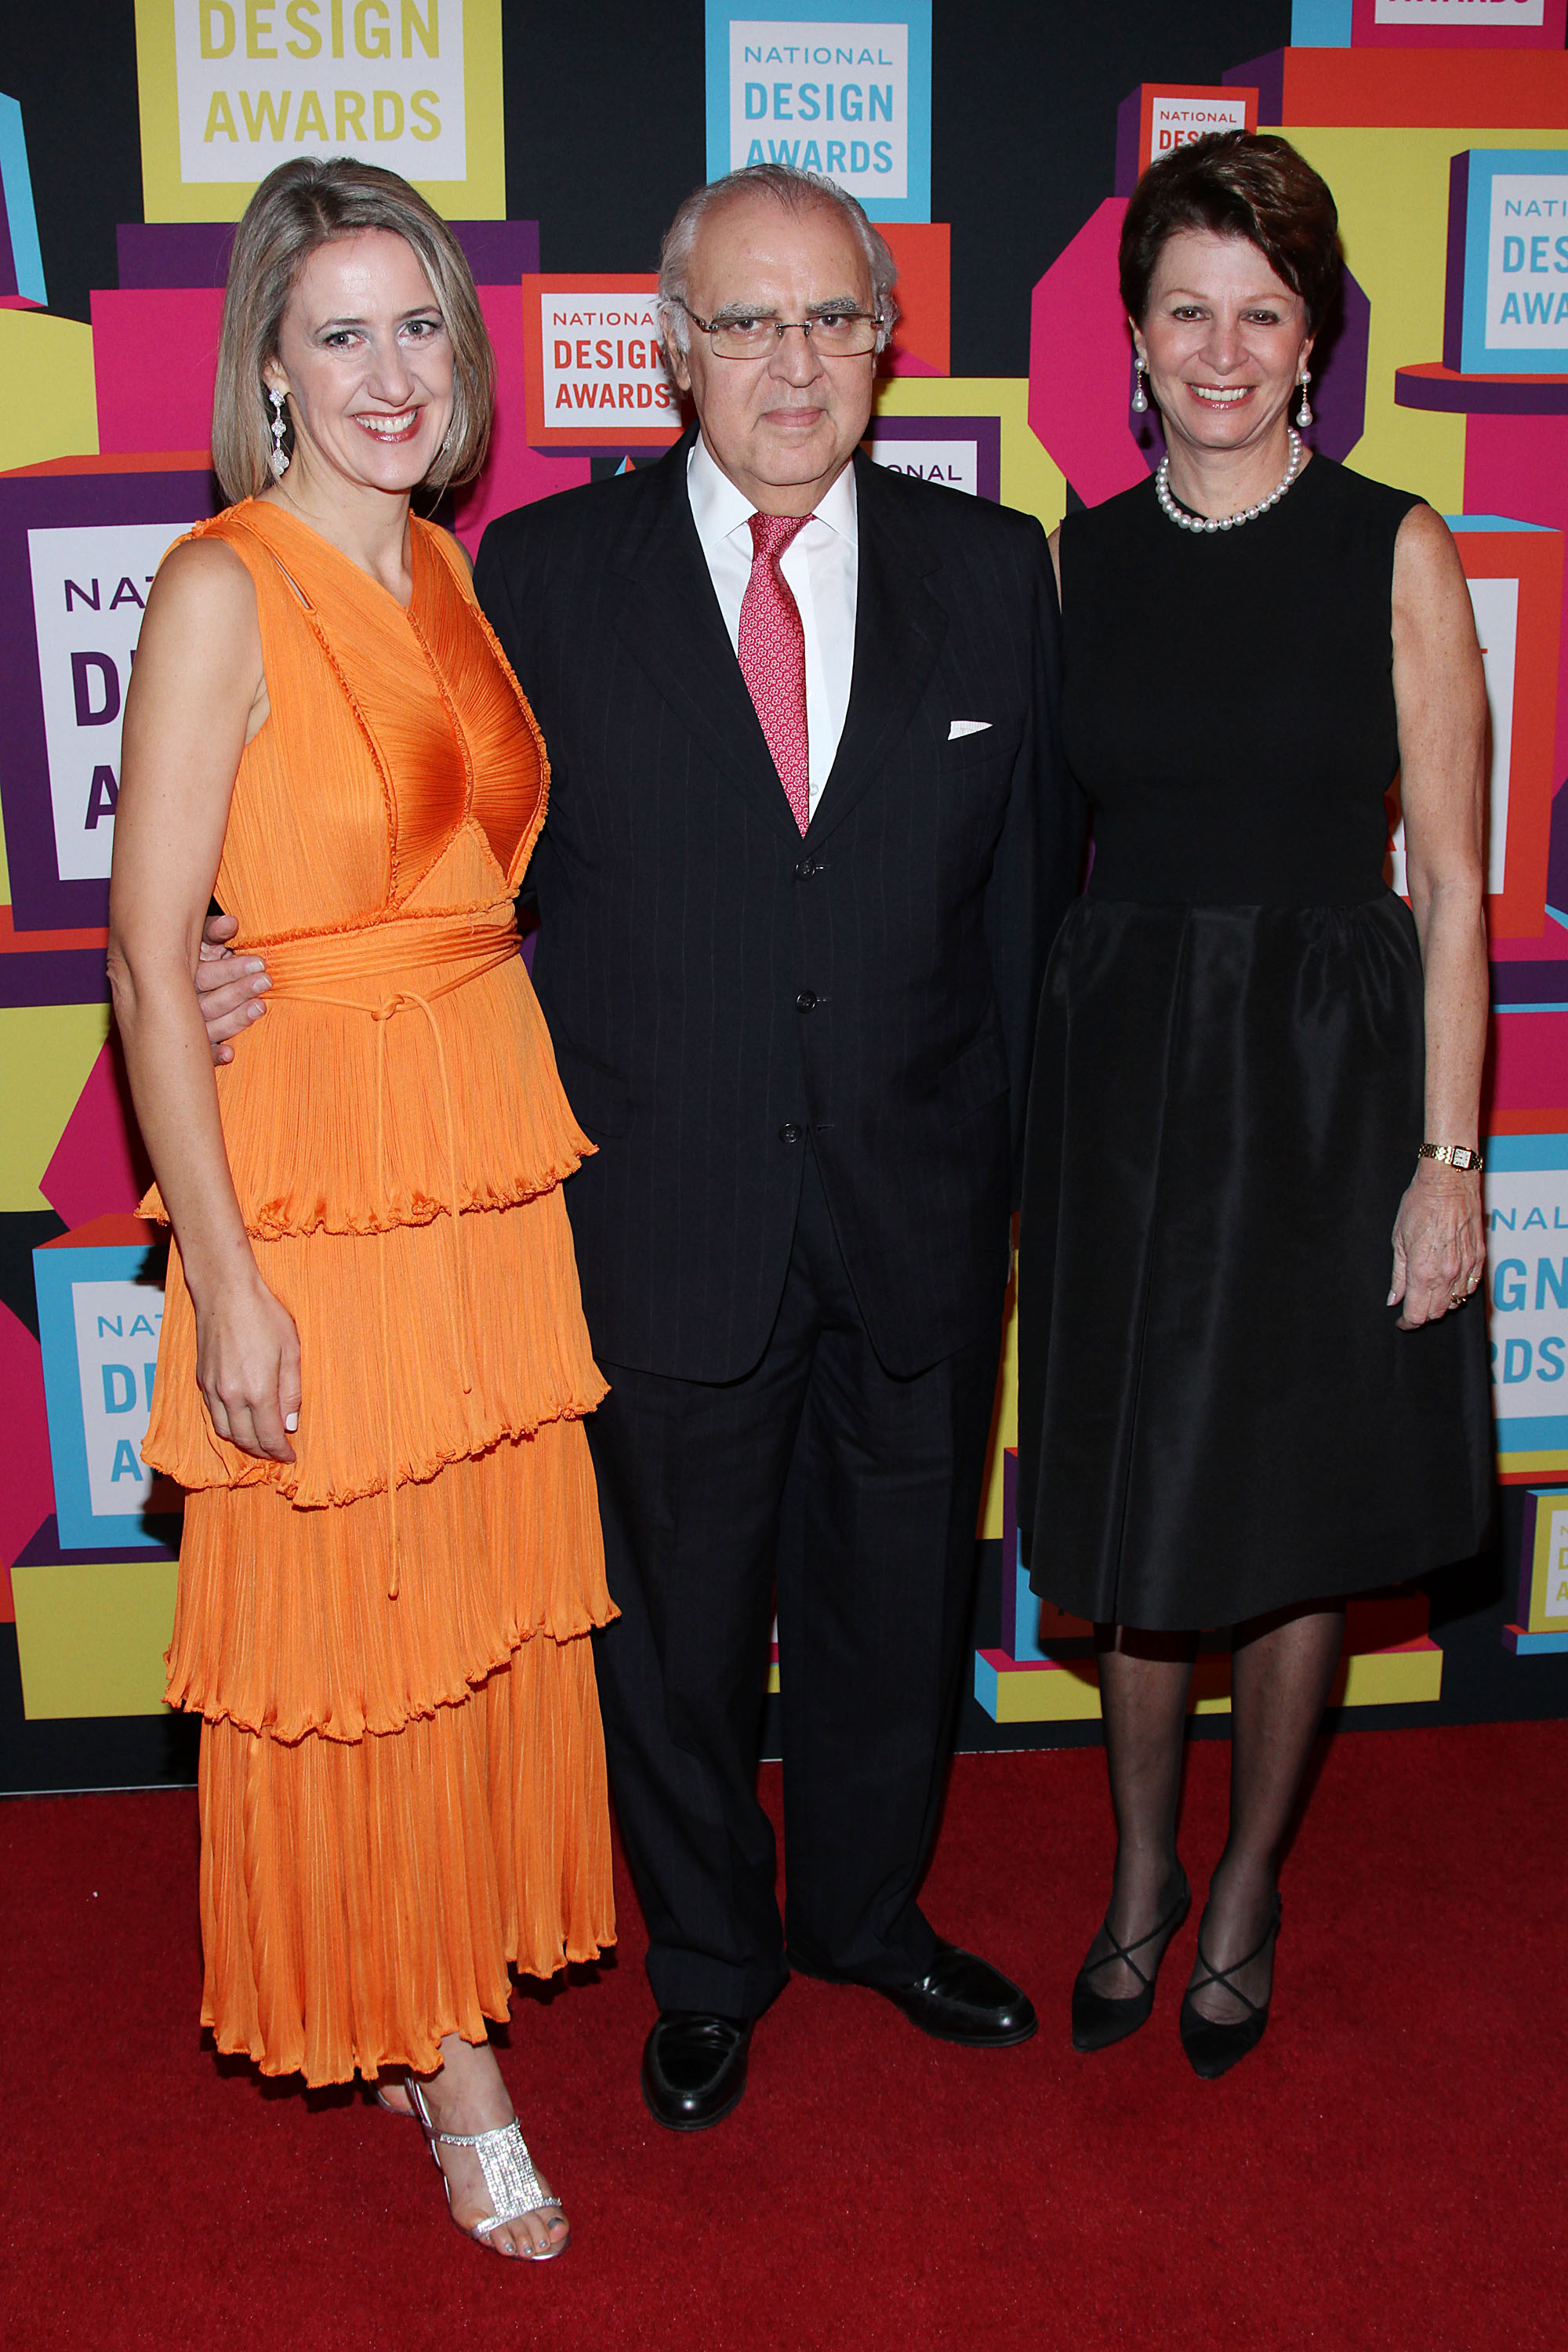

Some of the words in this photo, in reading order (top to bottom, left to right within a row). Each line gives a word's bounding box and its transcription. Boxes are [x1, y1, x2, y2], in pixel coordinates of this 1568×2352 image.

[198, 0, 439, 59] DESIGN
[745, 45, 893, 65] NATIONAL
[203, 89, 441, 143] AWARDS
[745, 82, 893, 122] DESIGN
[1160, 111, 1236, 123] NATIONAL
[746, 139, 893, 173] AWARDS
[1504, 199, 1568, 216] NATI
[1503, 235, 1568, 274] DES
[554, 312, 654, 325] NATIONA
[1500, 292, 1568, 324] AWA
[555, 383, 670, 408] AWARDS
